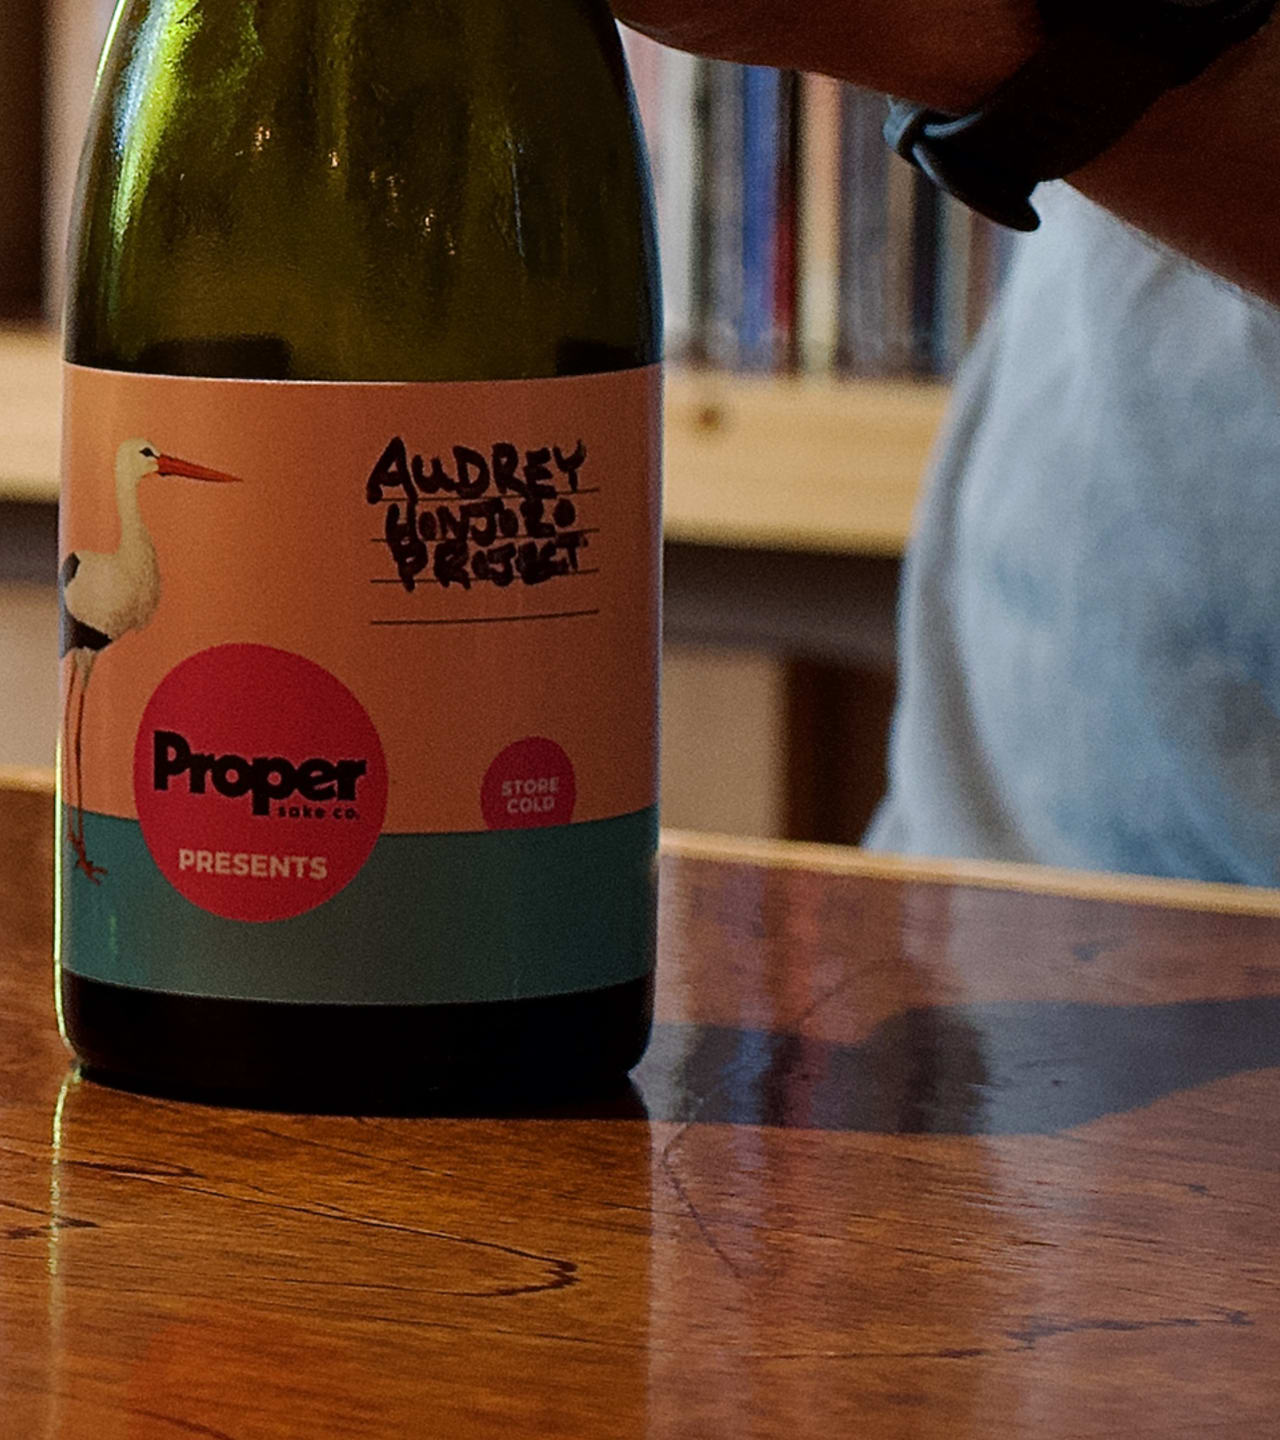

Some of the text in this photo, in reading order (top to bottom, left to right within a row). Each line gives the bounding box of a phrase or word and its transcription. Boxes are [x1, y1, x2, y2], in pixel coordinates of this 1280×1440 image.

[366, 436, 587, 504] AUDREY
[154, 730, 367, 817] Proper
[501, 776, 560, 798] STORE
[278, 805, 324, 820] sake
[506, 796, 556, 815] COLD
[178, 847, 329, 880] PRESENTS
